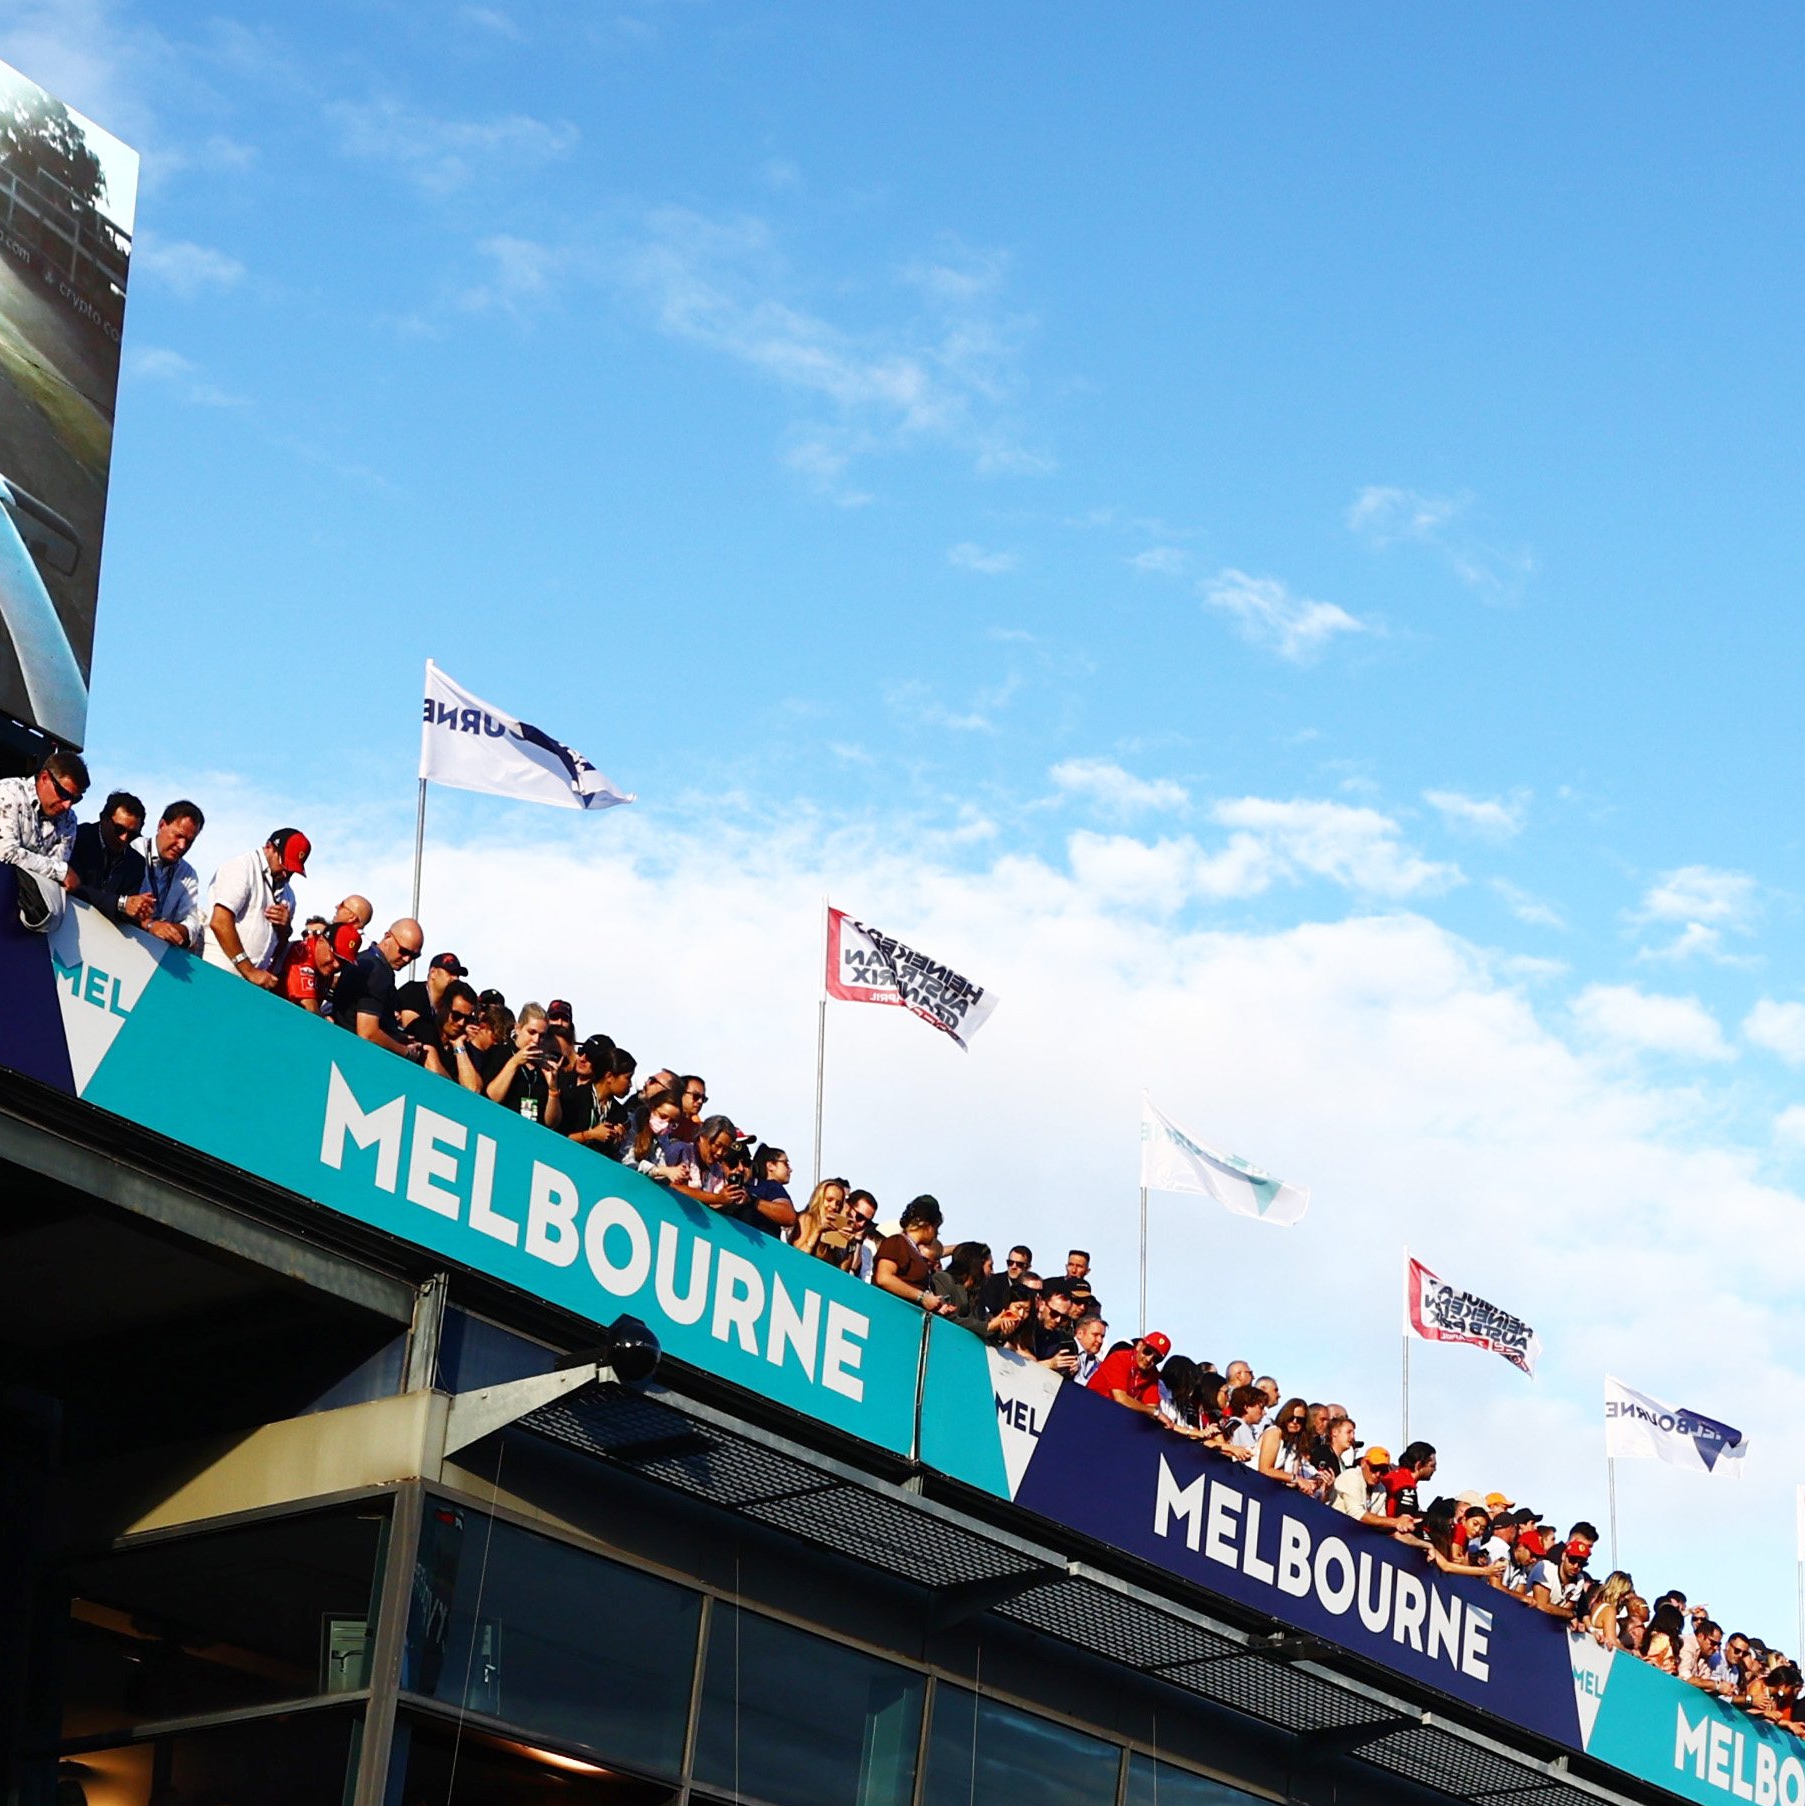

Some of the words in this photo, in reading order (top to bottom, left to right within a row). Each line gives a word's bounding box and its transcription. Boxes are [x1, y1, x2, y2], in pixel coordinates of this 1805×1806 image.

[53, 961, 128, 1018] MEL
[320, 1060, 870, 1402] MELBOURNE
[995, 1391, 1043, 1439] MEL
[1156, 1452, 1494, 1684] MELBOURNE
[1572, 1662, 1603, 1700] MEL
